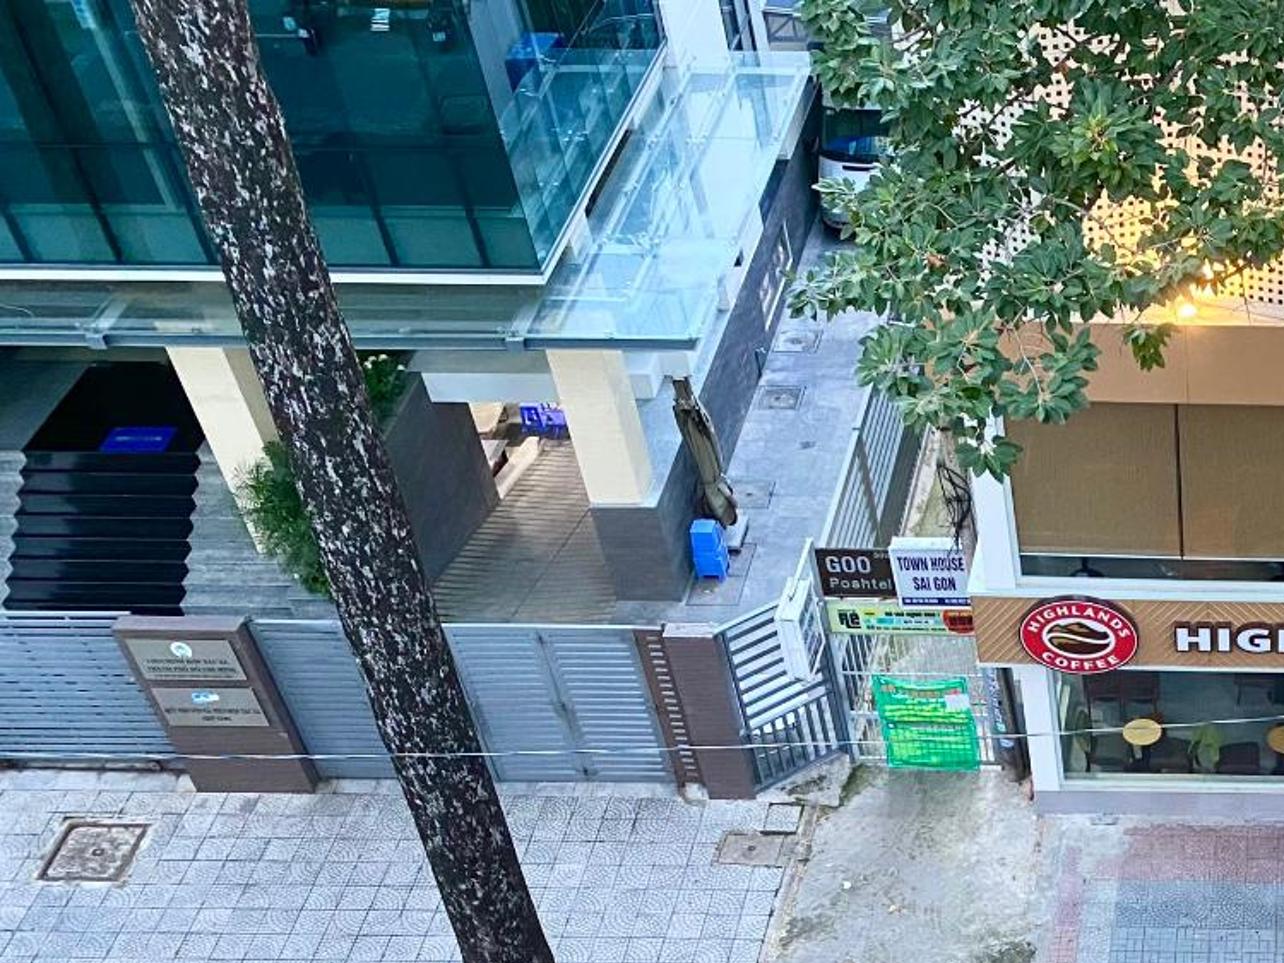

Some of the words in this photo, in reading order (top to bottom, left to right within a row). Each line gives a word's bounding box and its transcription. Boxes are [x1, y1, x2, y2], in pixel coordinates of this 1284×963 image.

[897, 557, 928, 572] TOWN
[931, 557, 965, 572] HOUSE
[829, 577, 892, 590] Poshtel
[912, 577, 931, 591] SAI
[934, 577, 957, 591] GON
[1027, 605, 1131, 638] HIGHLANDS
[1042, 651, 1120, 670] COFFEE
